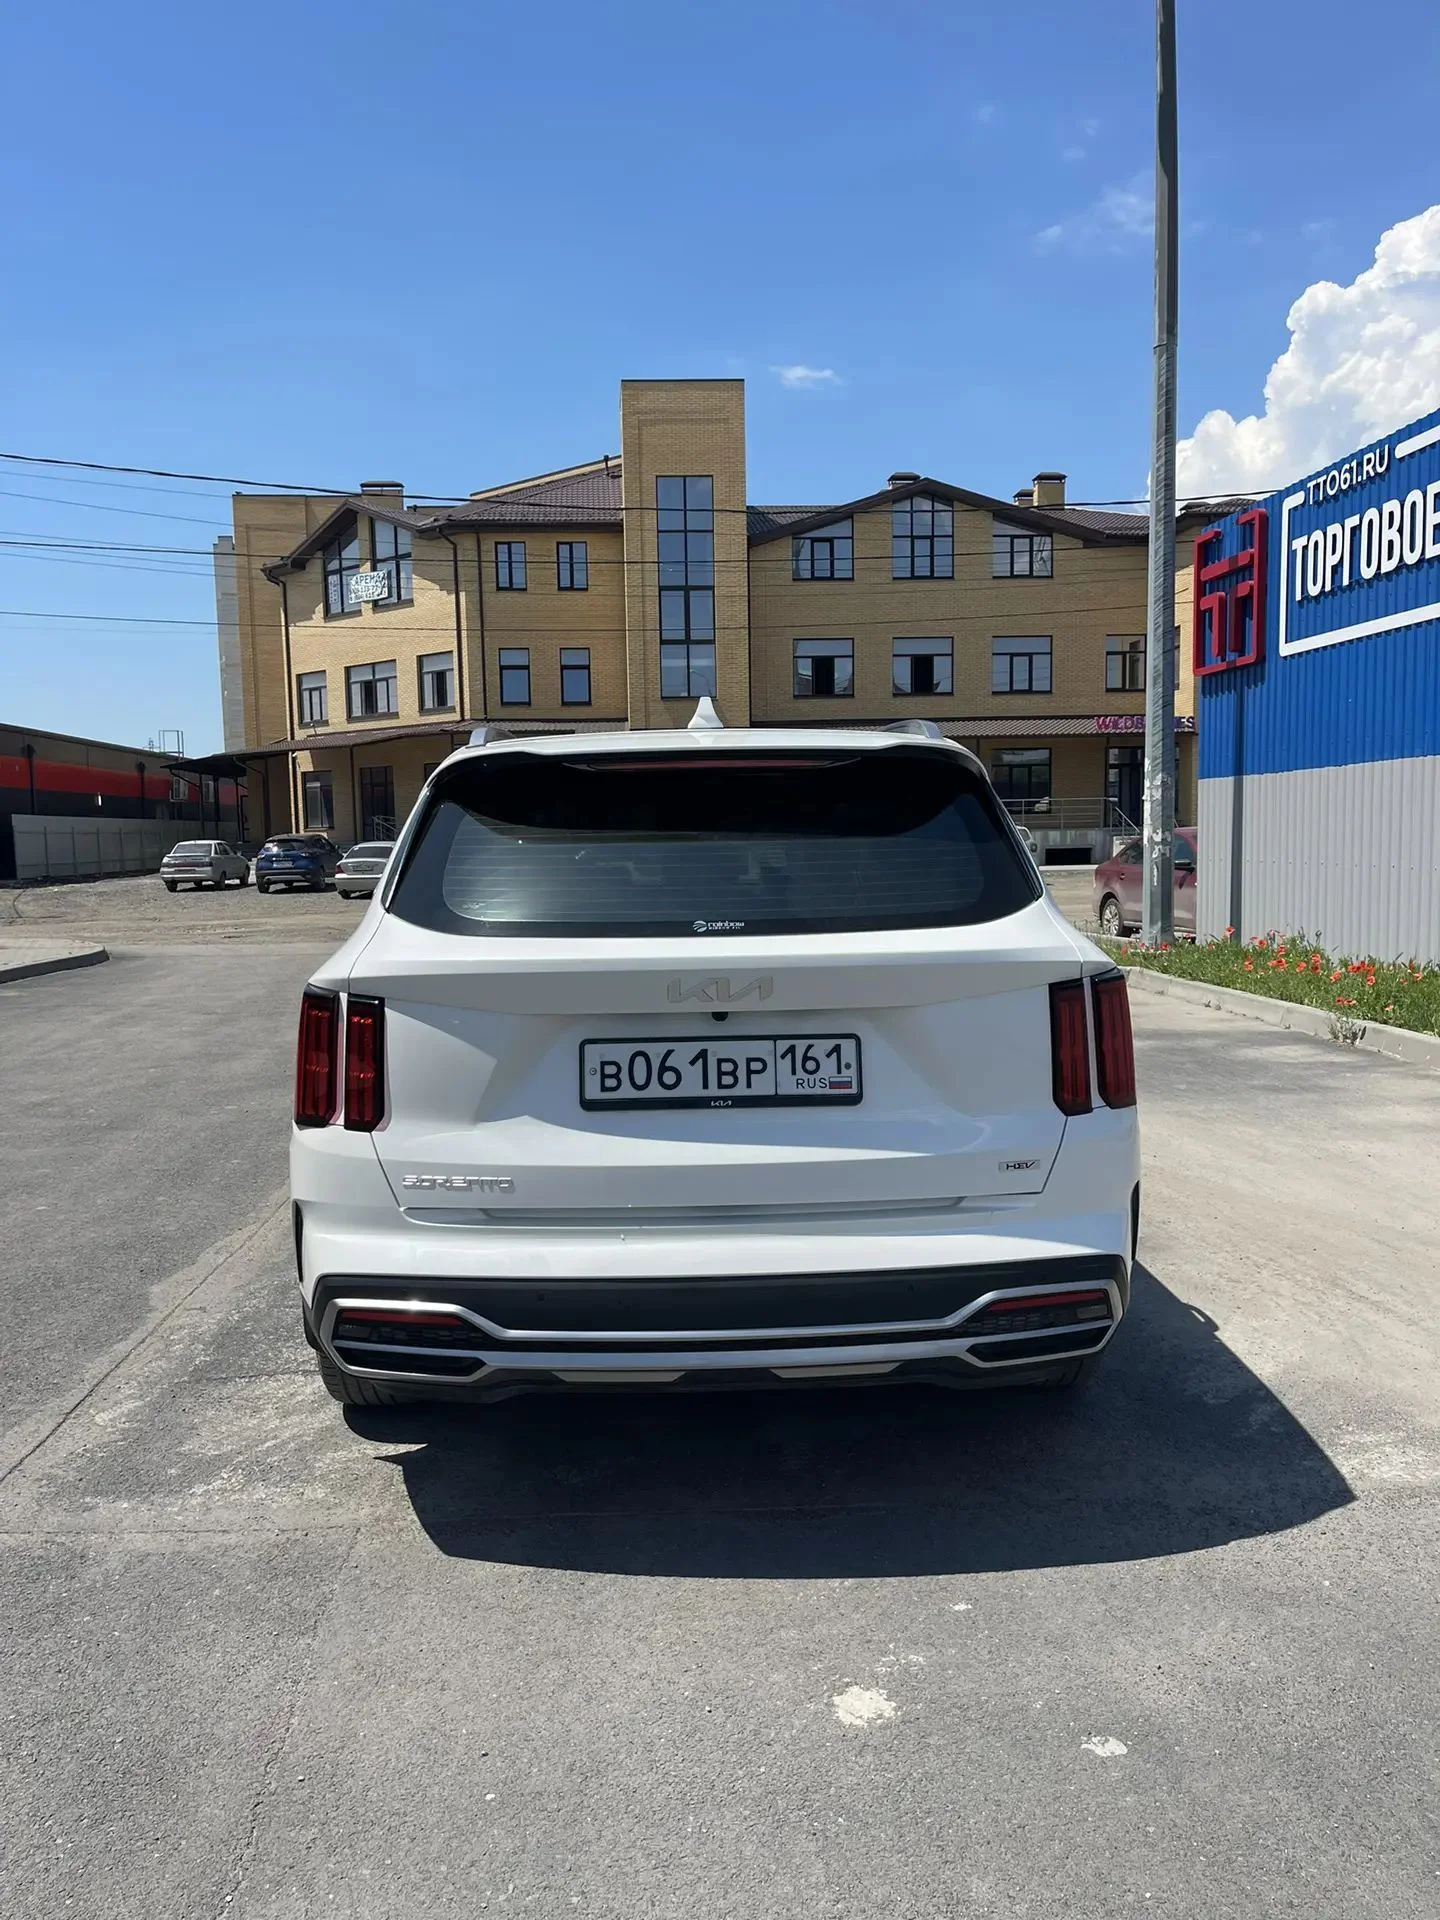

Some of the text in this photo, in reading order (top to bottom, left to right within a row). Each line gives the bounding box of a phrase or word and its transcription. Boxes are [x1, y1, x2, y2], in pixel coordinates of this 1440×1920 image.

[1307, 444, 1389, 504] TTO61.RU
[1292, 480, 1440, 601] ТОРГОВОЕ
[667, 976, 774, 1003] KIA
[780, 1044, 842, 1077] 161
[796, 1077, 828, 1089] RUS
[711, 1100, 732, 1108] KIA
